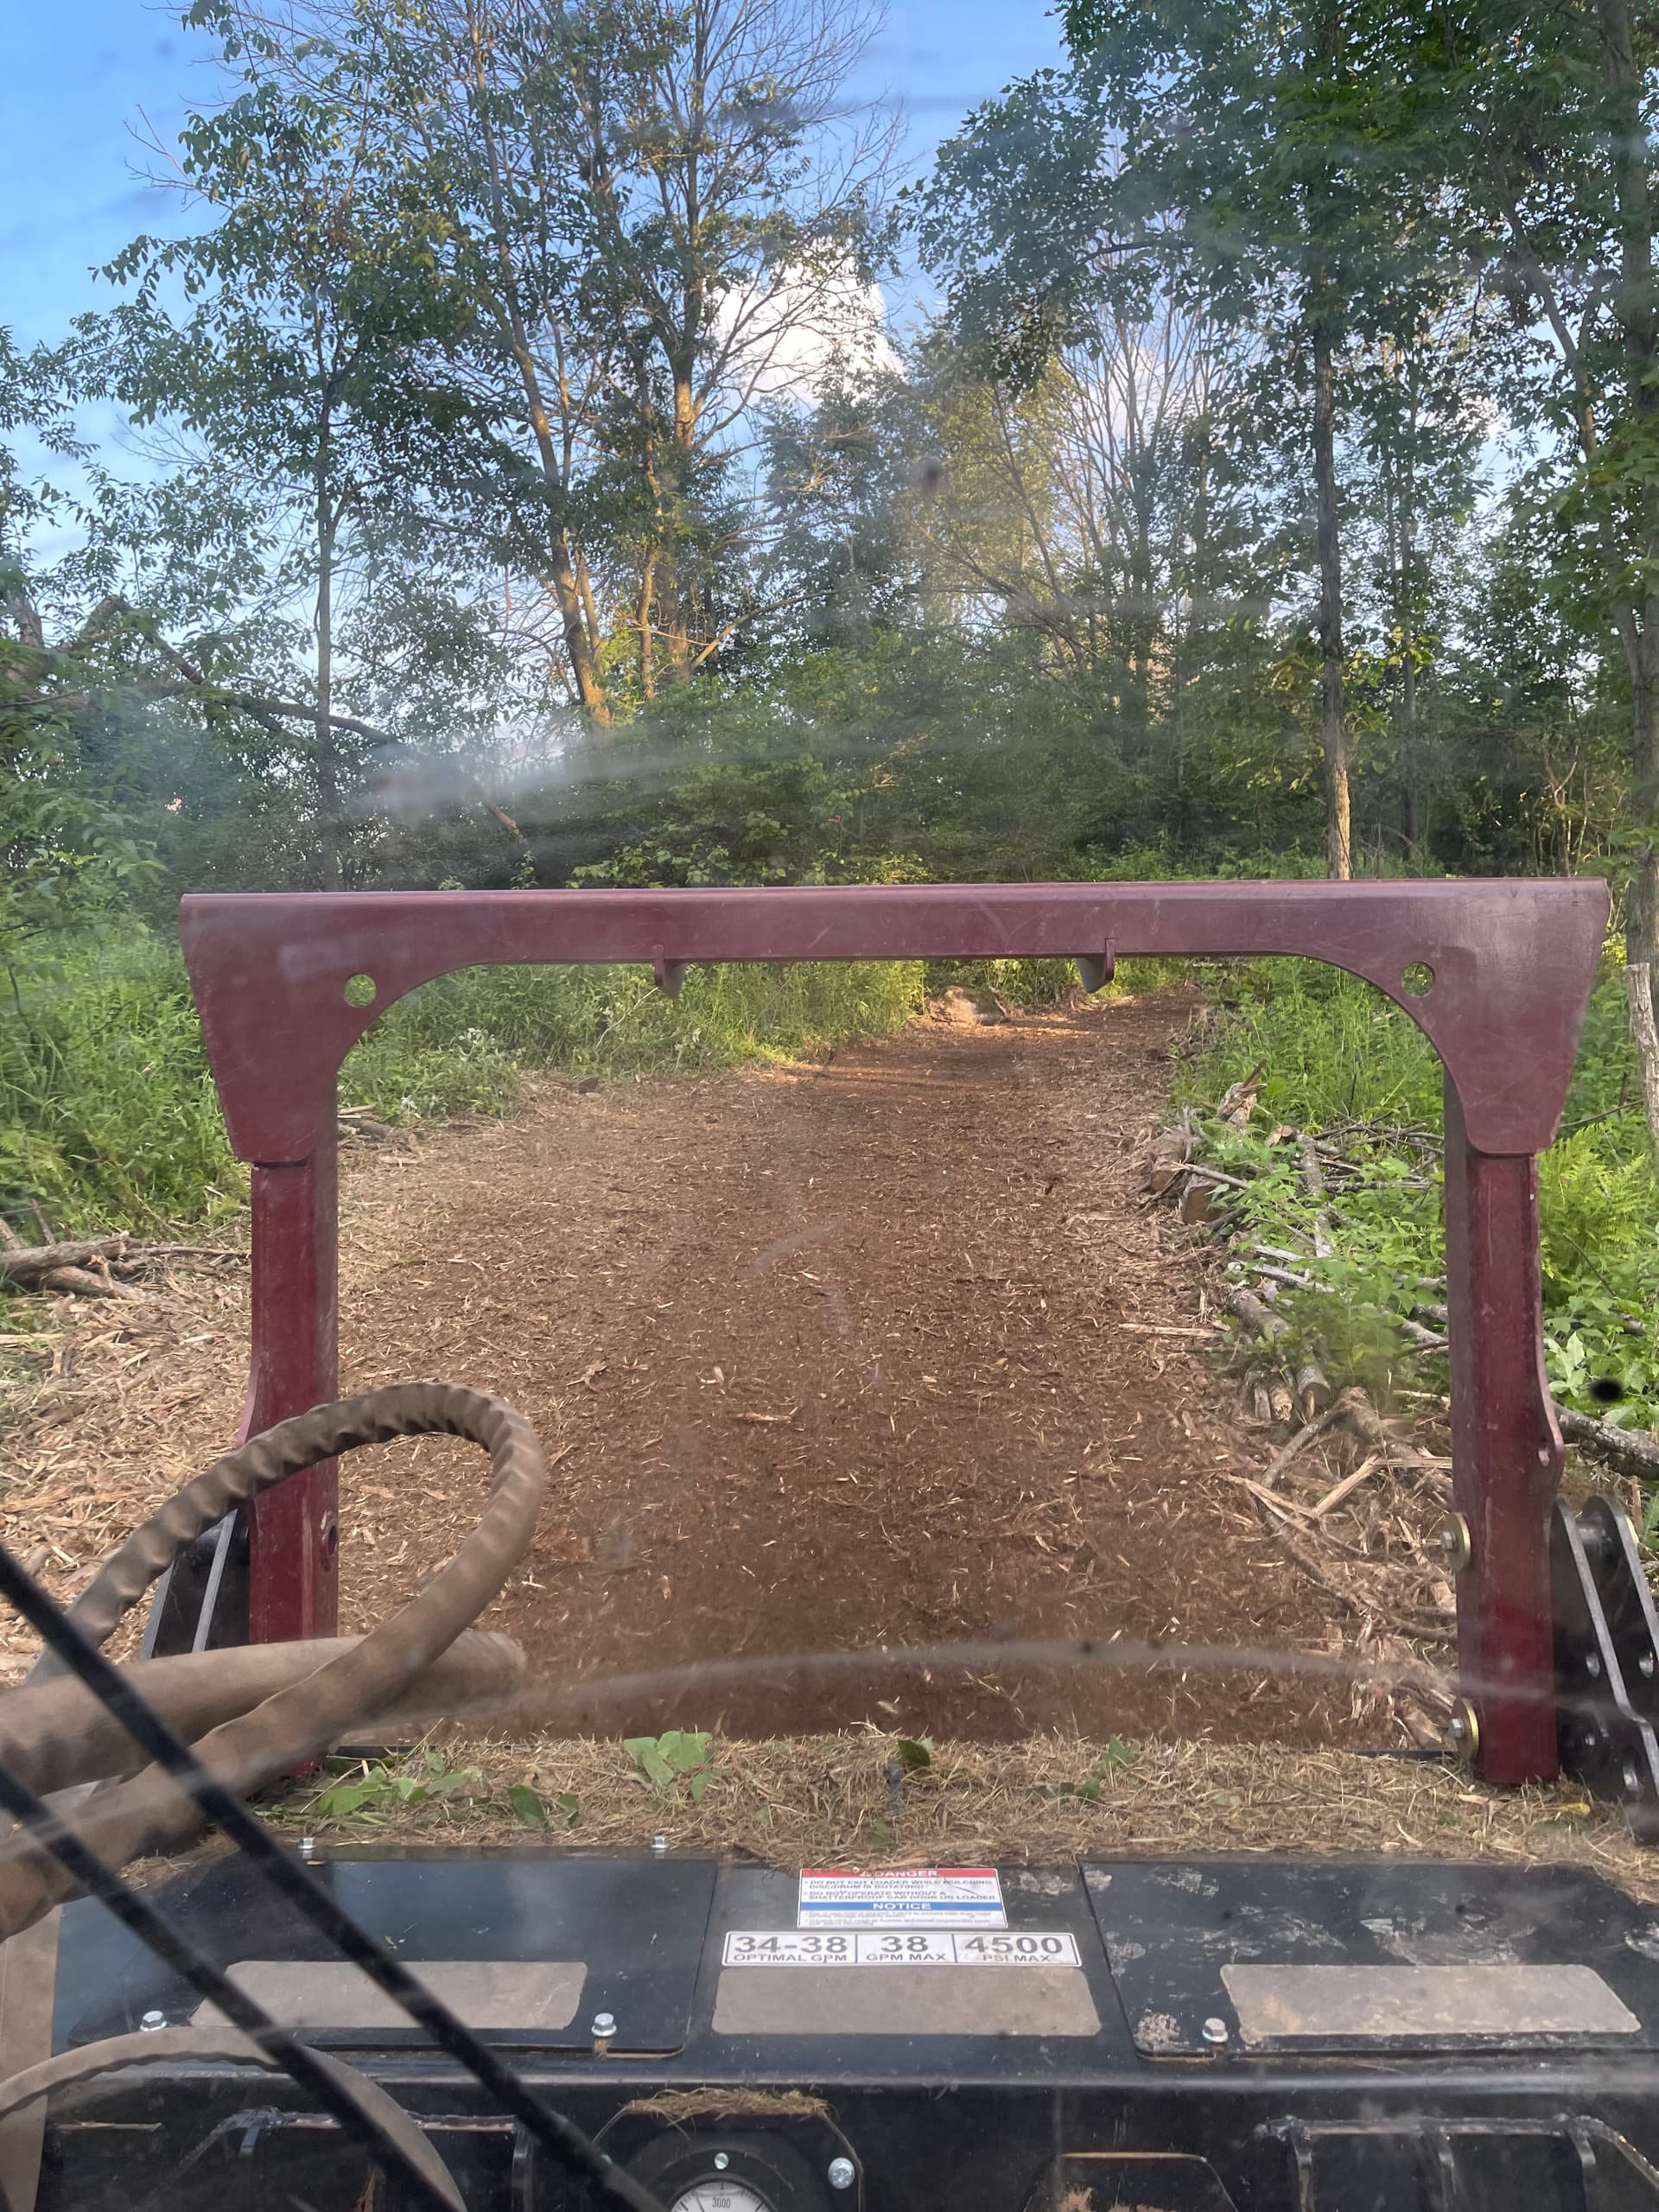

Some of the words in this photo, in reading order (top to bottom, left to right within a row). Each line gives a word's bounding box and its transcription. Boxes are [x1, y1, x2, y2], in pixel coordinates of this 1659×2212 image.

[734, 1936, 848, 1954] 34-38
[880, 1936, 929, 1953] 38
[965, 1936, 1064, 1954] 4500
[734, 1954, 808, 1962] OPTIMAL
[810, 1954, 847, 1962] GPM
[712, 2197, 730, 2209] 3000
